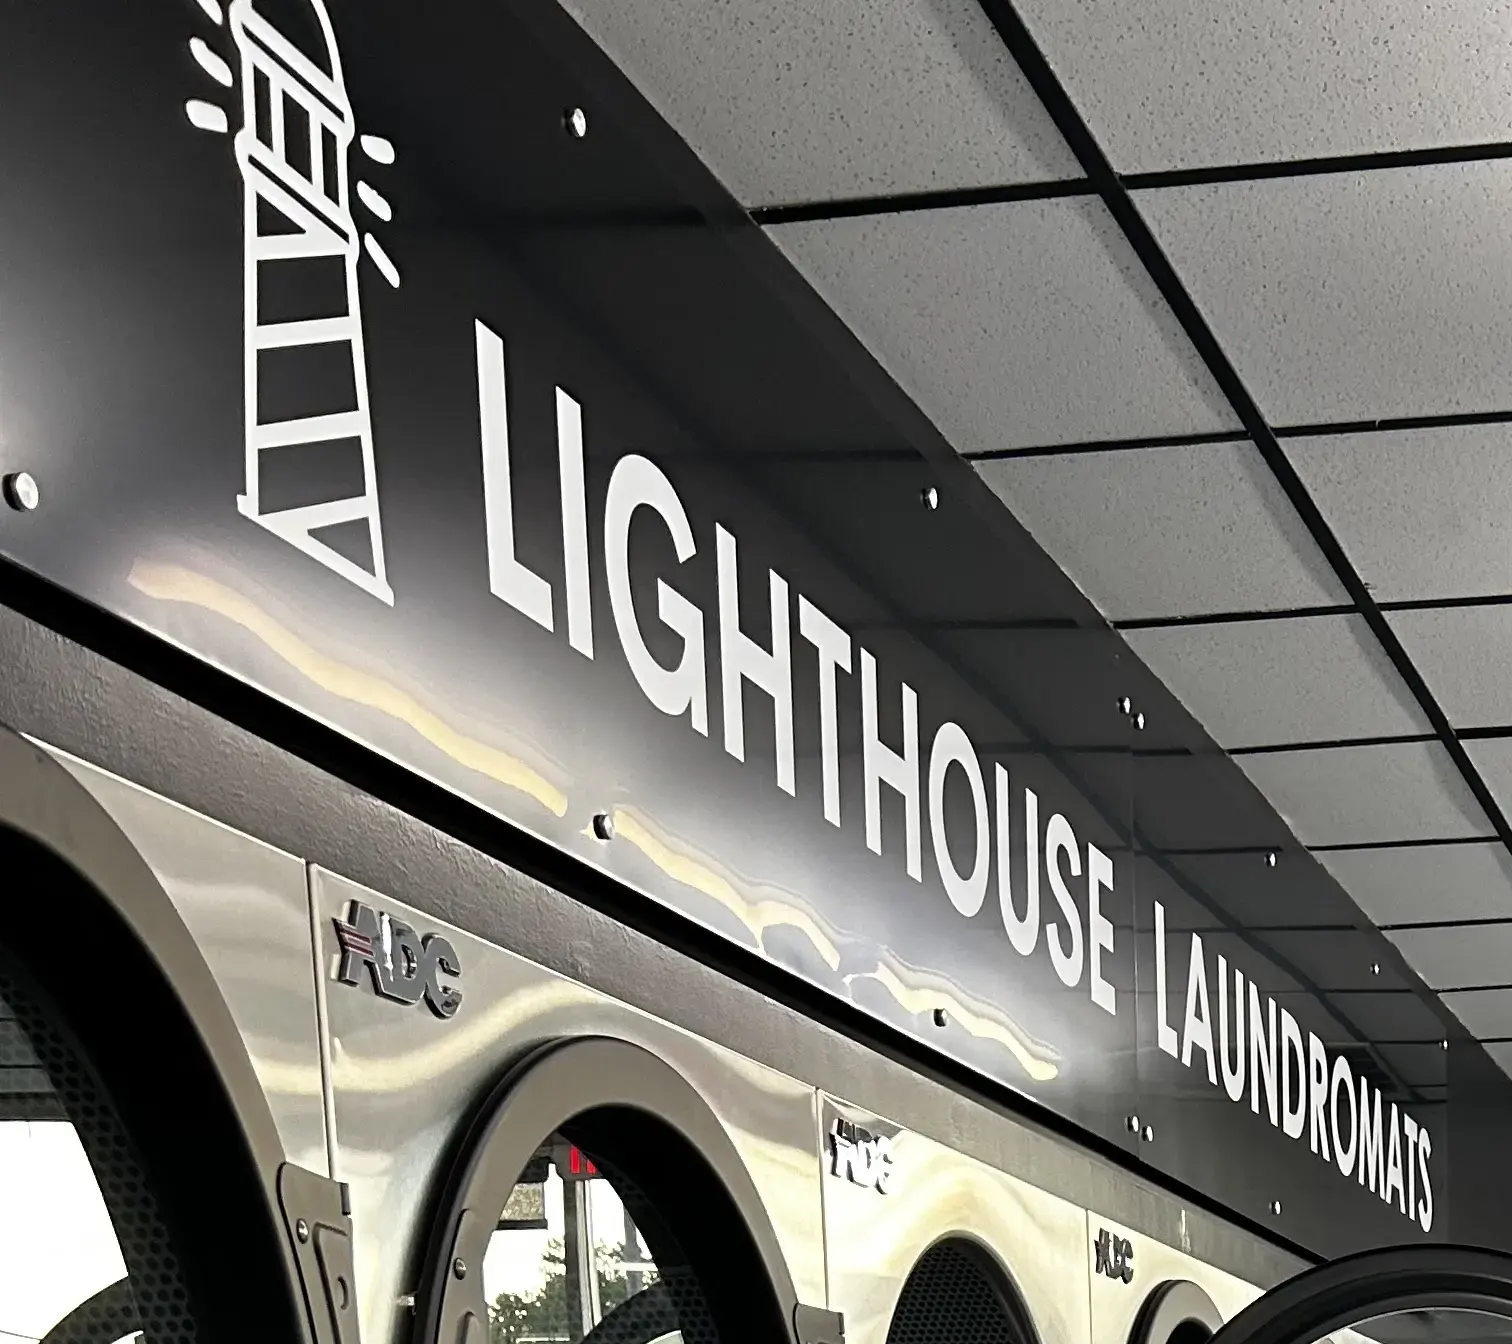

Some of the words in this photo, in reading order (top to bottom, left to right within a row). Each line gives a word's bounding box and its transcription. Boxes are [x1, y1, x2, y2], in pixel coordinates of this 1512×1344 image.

[332, 899, 463, 1019] ADC
[475, 318, 1116, 1015] LIGHTHOUSE
[1152, 900, 1433, 1233] LAUNDROMATS
